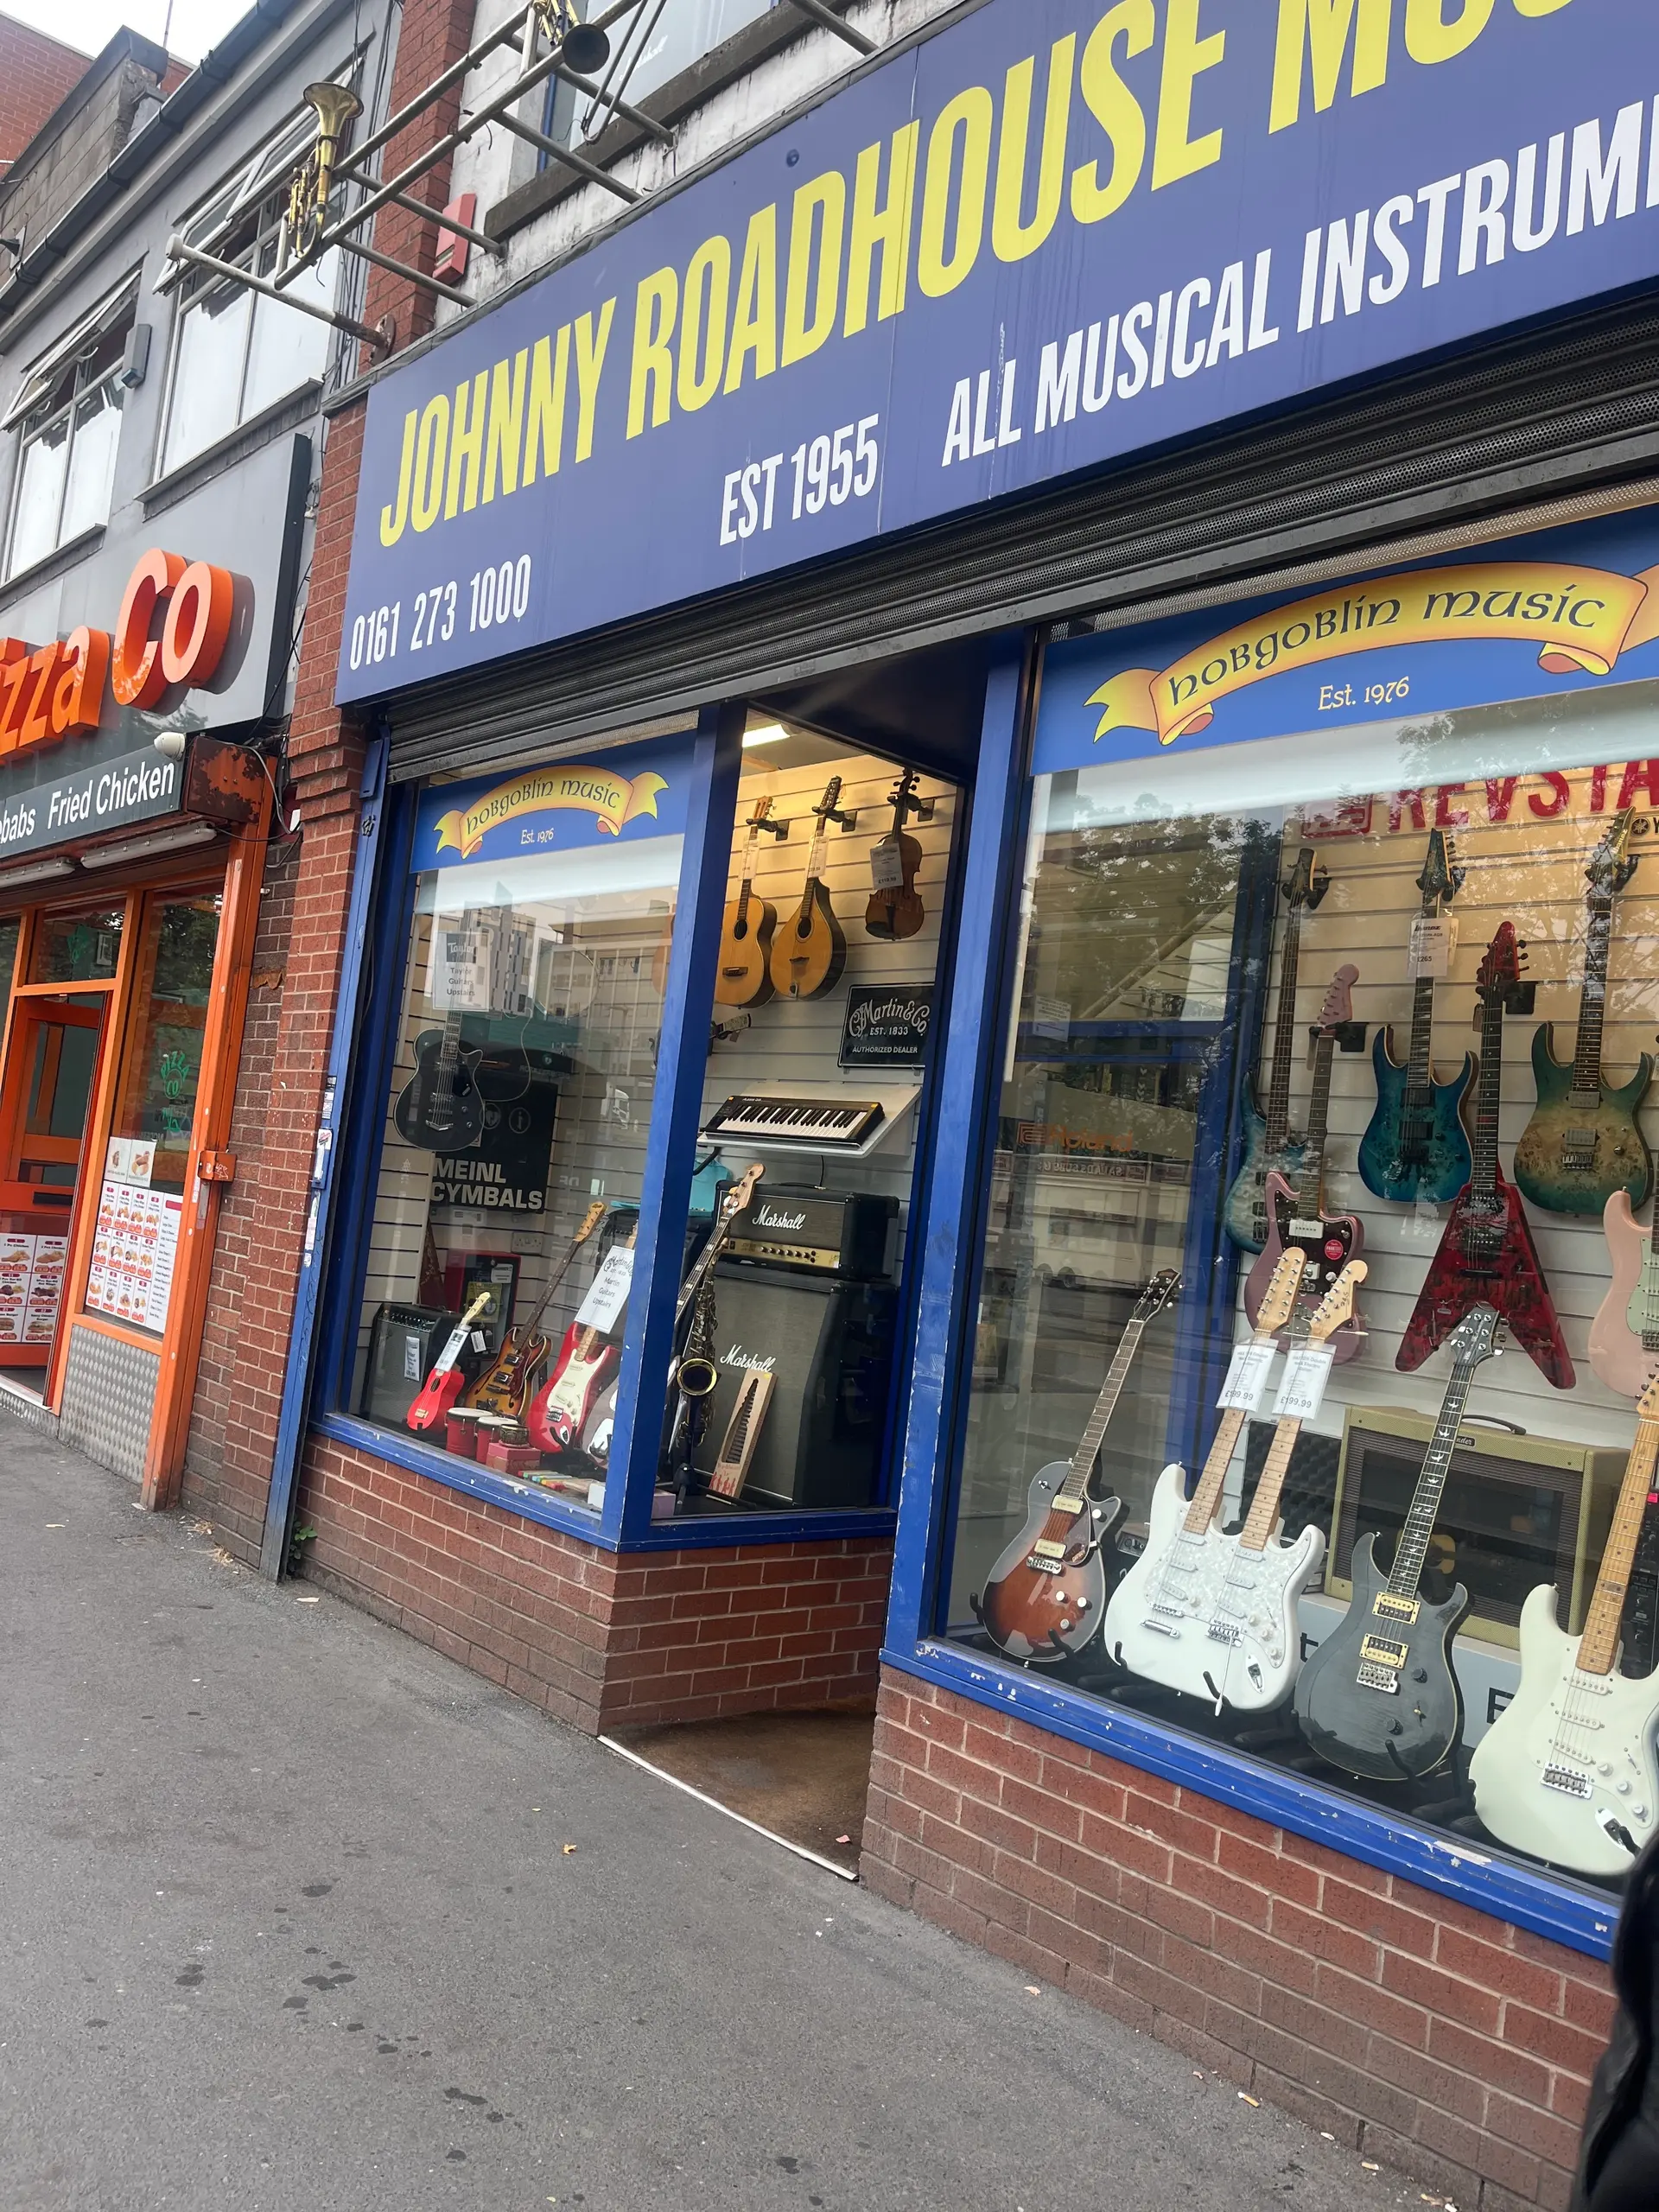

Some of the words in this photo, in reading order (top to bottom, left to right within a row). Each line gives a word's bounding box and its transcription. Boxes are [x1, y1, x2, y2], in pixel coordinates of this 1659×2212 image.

[380, 296, 617, 548] JOHNNY
[626, 0, 1225, 441] ROADHOUSE
[941, 360, 1021, 467] ALL
[1035, 248, 1281, 435] MUSICAL
[1298, 93, 1659, 334] INSTRUM
[720, 452, 791, 546] EST
[791, 413, 880, 520] 1955
[349, 600, 400, 671] 0161
[410, 580, 456, 652] 273
[469, 554, 531, 632] 1000
[112, 548, 232, 709] Co
[1319, 683, 1357, 712] Est.
[1363, 676, 1411, 706] 1976
[48, 779, 94, 830] Fried
[96, 761, 175, 816] Chicken
[520, 829, 535, 845] Est.
[537, 827, 555, 843] 1976
[447, 988, 475, 997] Upstairs
[870, 1027, 887, 1036] EST.
[889, 1027, 909, 1035] 1833
[433, 1158, 506, 1184] MEINL
[431, 1182, 543, 1210] CYMBALS
[752, 1205, 806, 1230] Marshall
[599, 1287, 615, 1297] Guitars
[604, 1277, 620, 1287] Martin
[593, 1298, 611, 1308] Upstairs
[720, 1344, 777, 1373] Marshall
